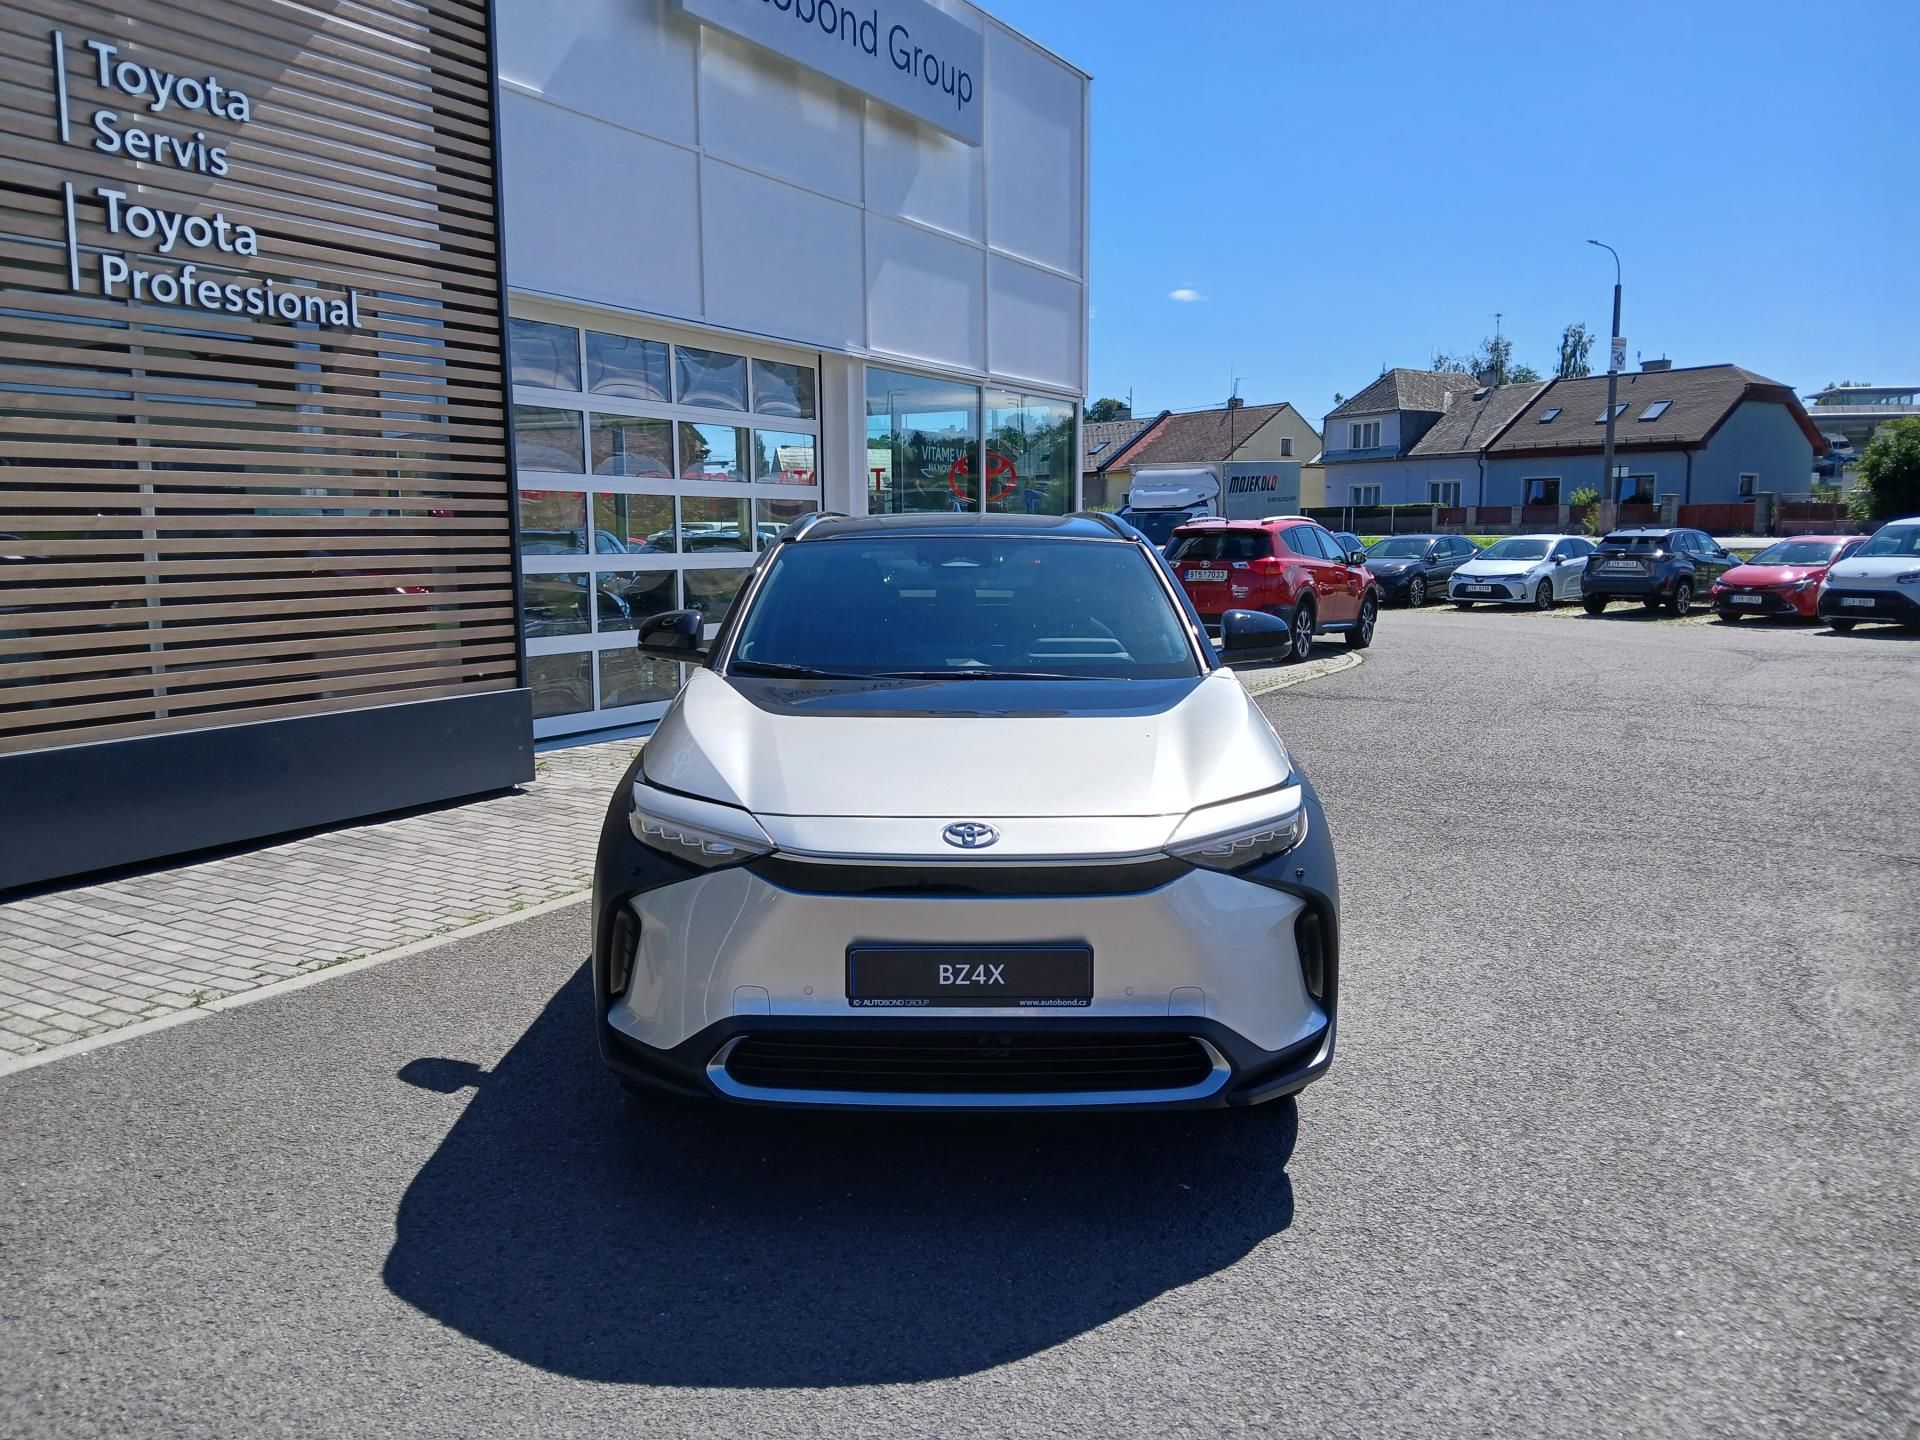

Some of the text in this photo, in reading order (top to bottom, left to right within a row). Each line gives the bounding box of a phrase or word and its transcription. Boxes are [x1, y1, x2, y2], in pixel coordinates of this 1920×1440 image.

[87, 39, 251, 123] Toyota
[888, 25, 973, 111] Group
[93, 110, 229, 176] Servis
[97, 188, 258, 257] Toyota
[101, 254, 363, 329] Professional
[1229, 474, 1278, 494] MOJEKOLO
[938, 963, 1006, 985] BZ4X
[1019, 999, 1087, 1007] www.autobond.cz
